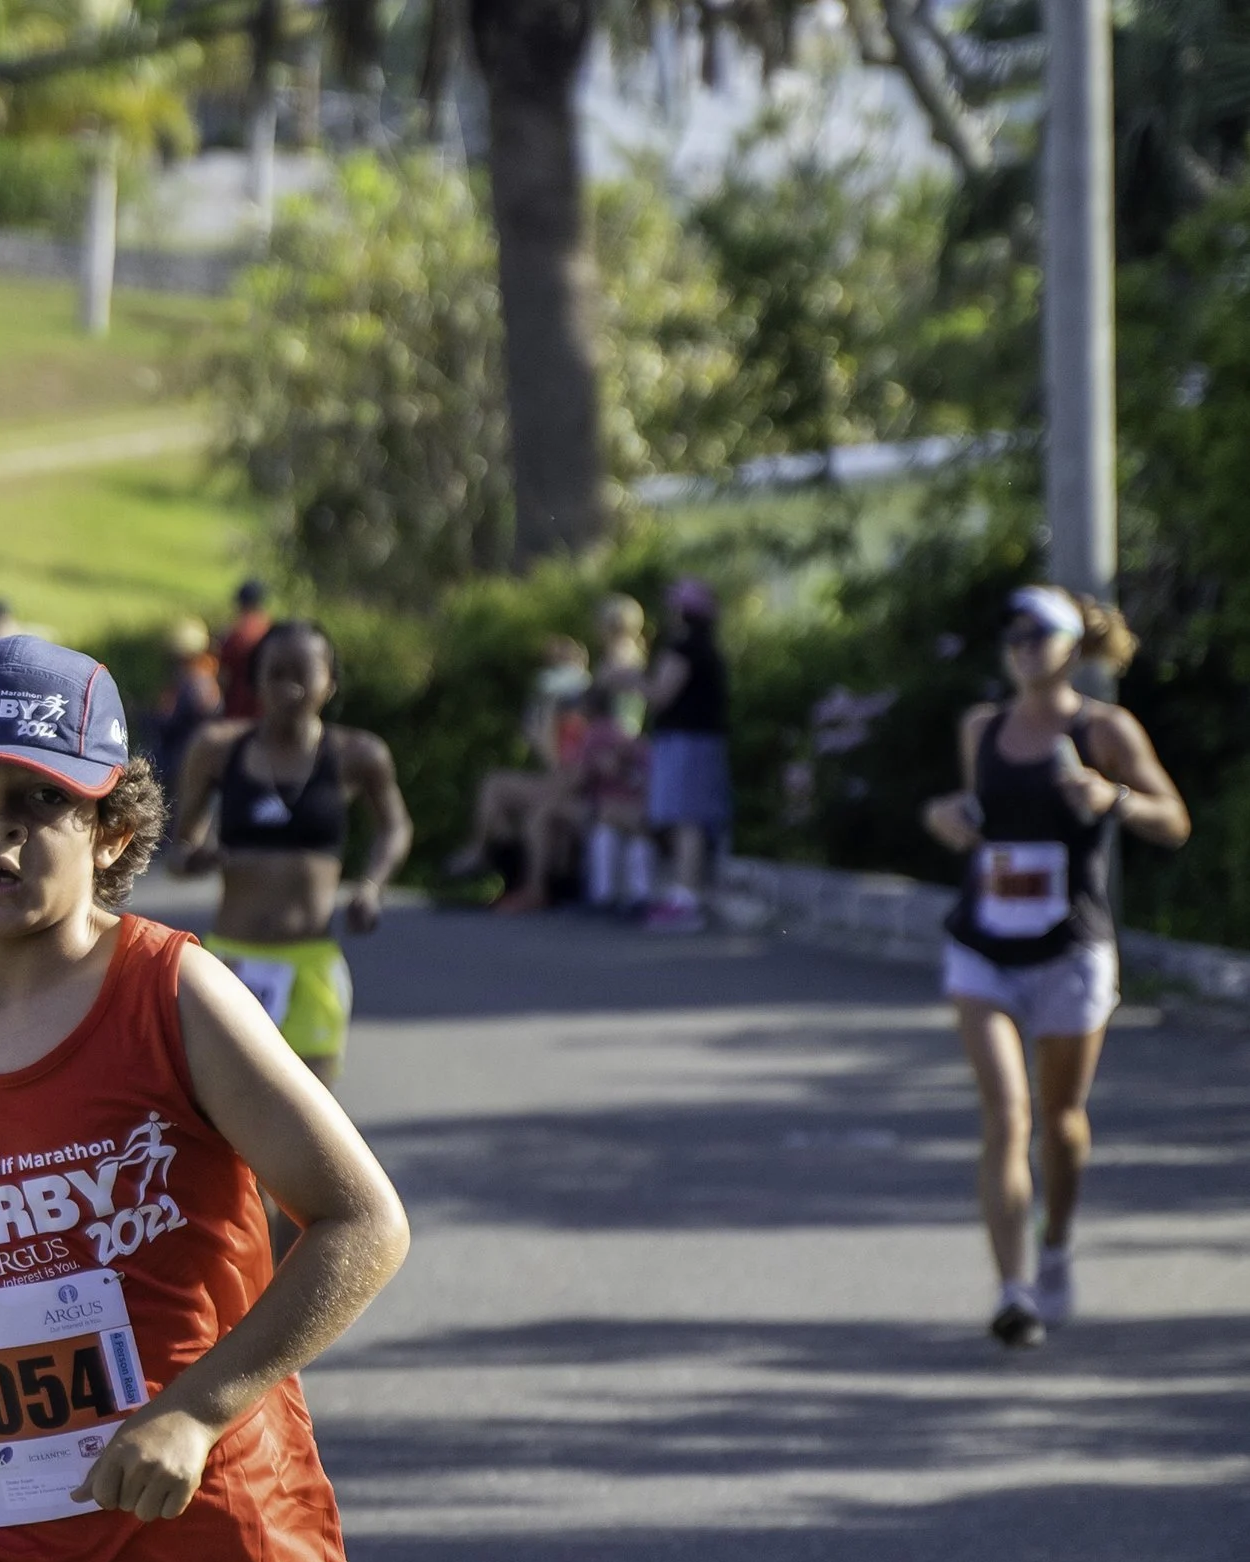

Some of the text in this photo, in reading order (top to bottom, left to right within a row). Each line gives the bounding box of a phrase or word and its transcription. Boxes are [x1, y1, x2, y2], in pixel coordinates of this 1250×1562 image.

[0, 690, 43, 699] Marathon
[17, 719, 58, 739] 2022
[18, 1137, 117, 1171] Marathon
[86, 1193, 188, 1266] 2022
[45, 1266, 55, 1278] is
[55, 1260, 81, 1275] You.
[44, 1300, 104, 1326] ARGUS
[113, 1332, 138, 1404] 4 Person Relay
